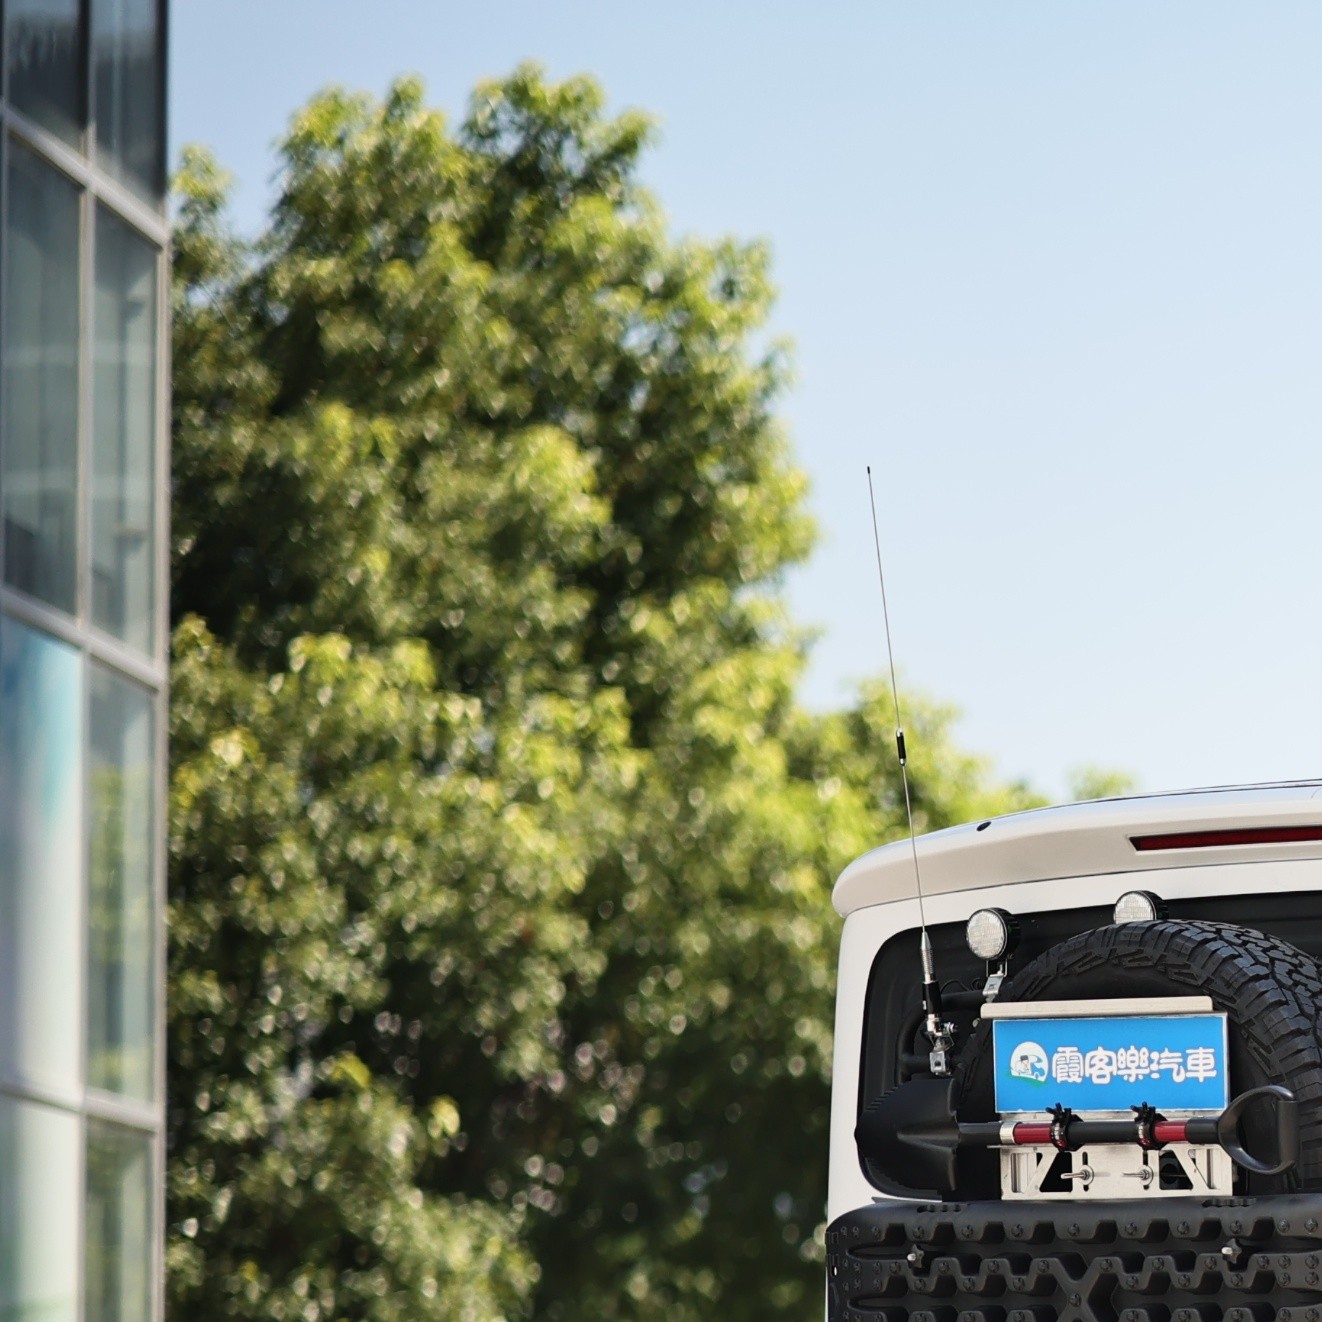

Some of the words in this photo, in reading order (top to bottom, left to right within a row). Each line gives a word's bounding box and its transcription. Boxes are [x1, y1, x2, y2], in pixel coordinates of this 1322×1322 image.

[1051, 1045, 1218, 1085] 霞客樂汽車
